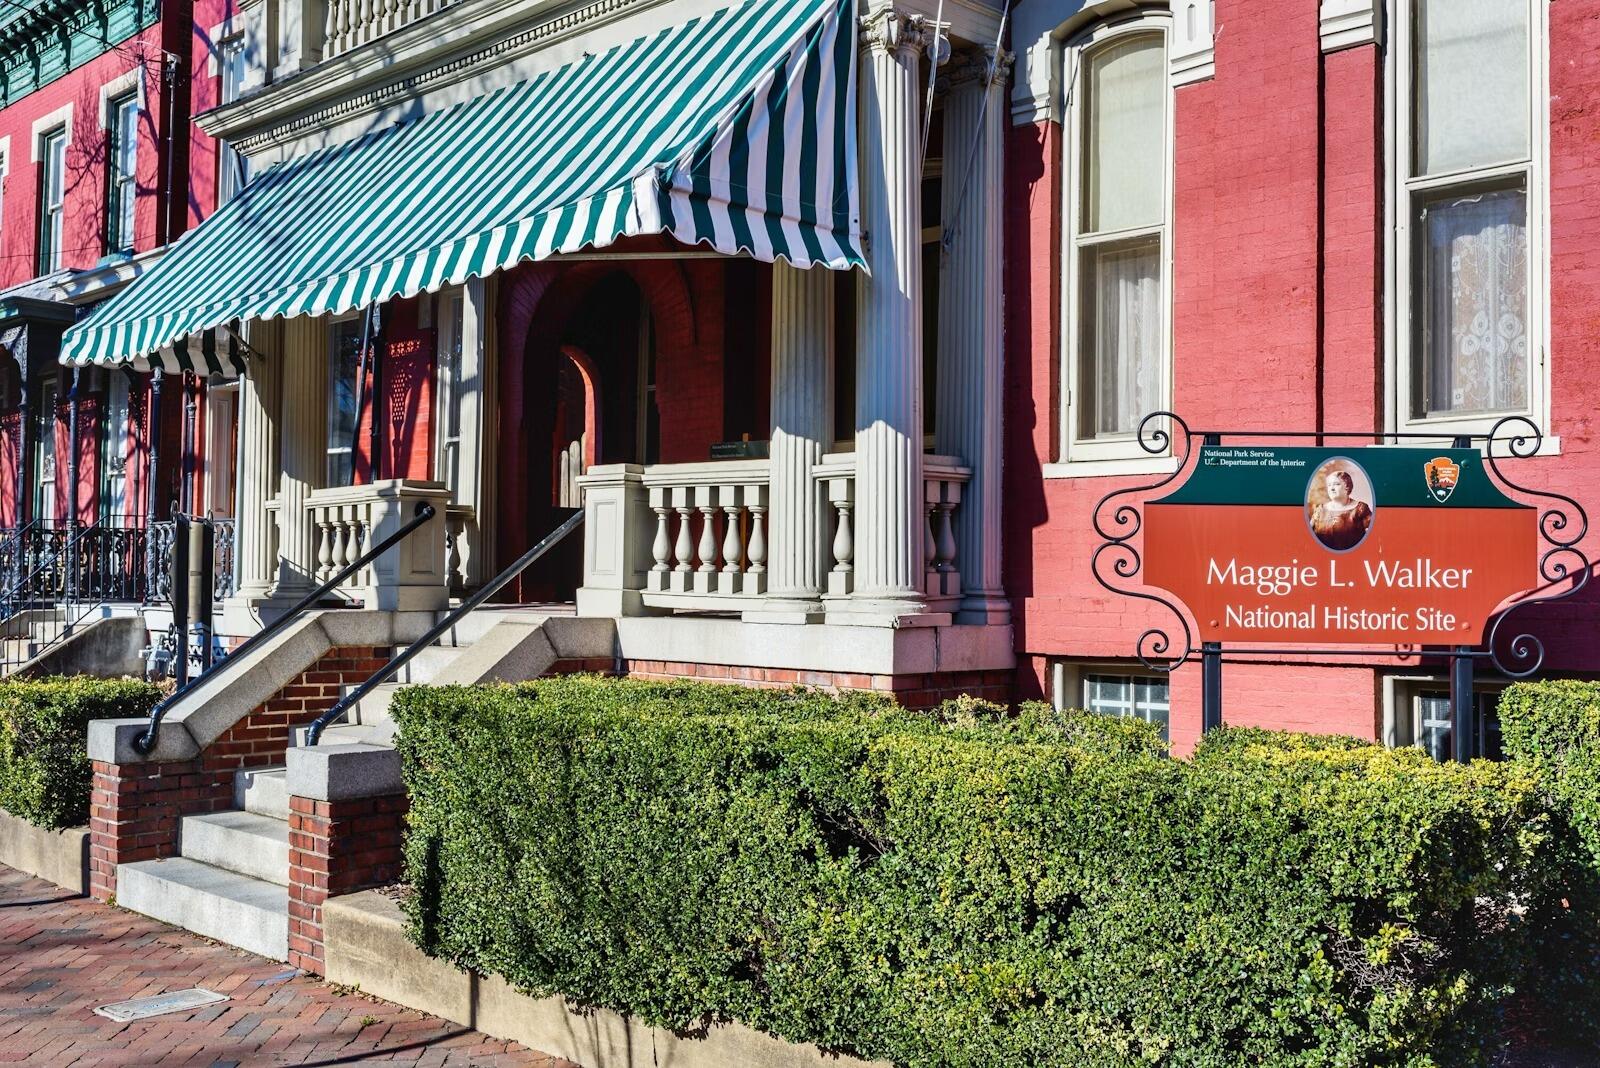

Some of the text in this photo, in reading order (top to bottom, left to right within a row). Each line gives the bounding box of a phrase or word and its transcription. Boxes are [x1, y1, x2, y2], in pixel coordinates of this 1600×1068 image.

[1220, 459, 1258, 467] Department
[1207, 558, 1473, 596] Maggie L. Walker
[1225, 604, 1456, 631] National Historic Site
